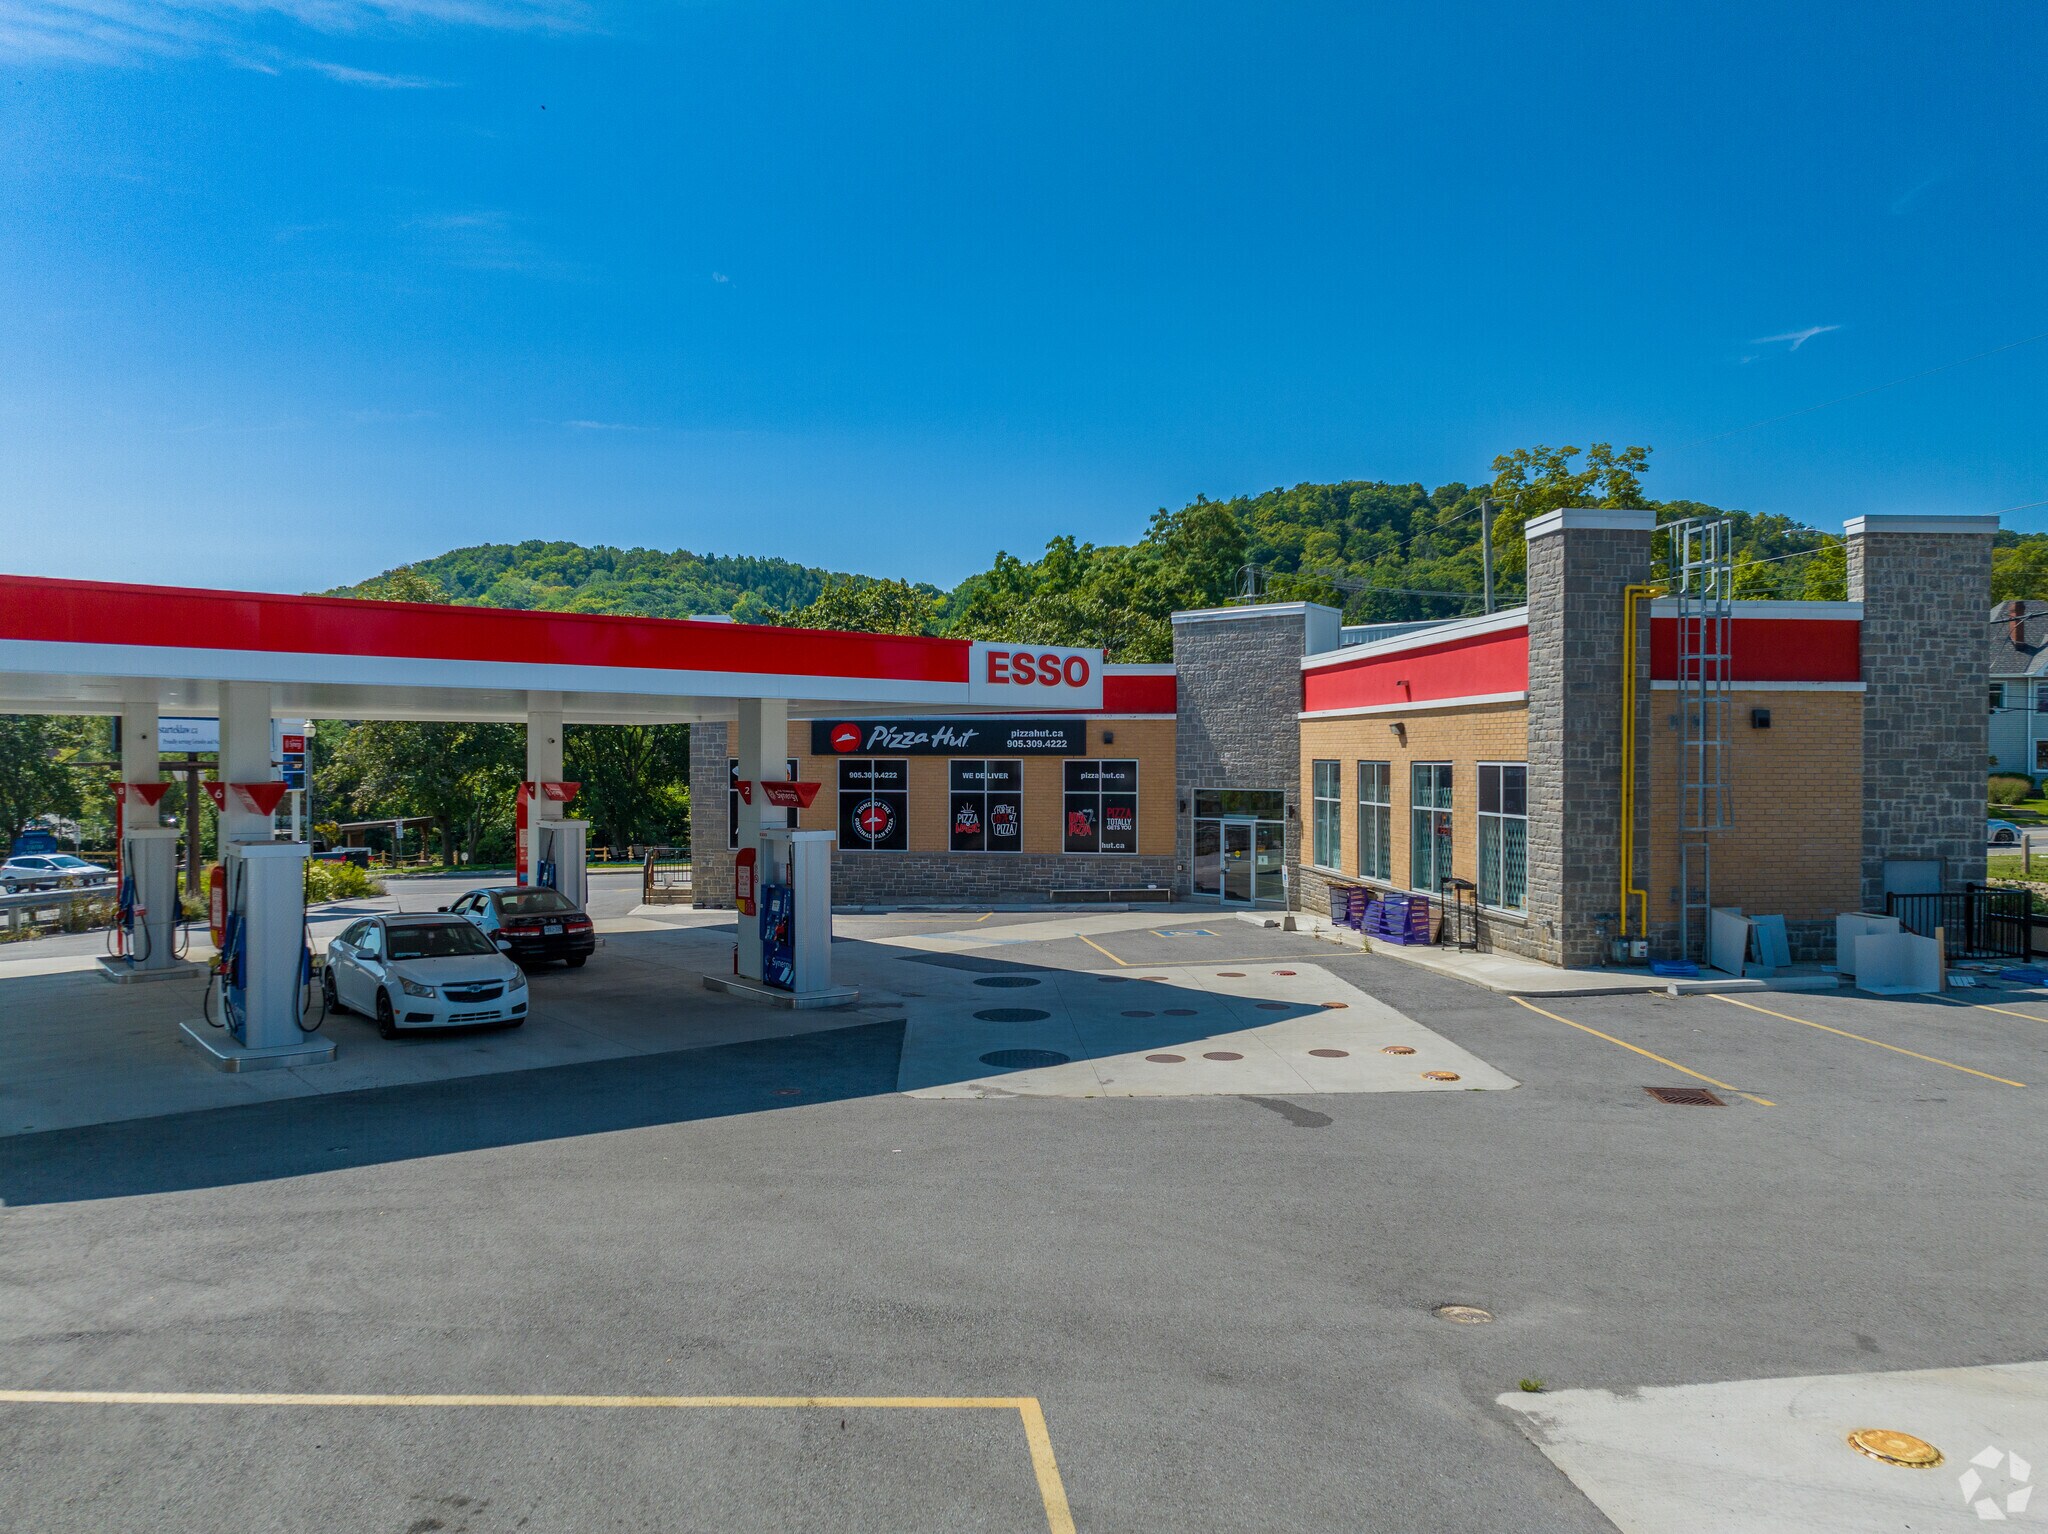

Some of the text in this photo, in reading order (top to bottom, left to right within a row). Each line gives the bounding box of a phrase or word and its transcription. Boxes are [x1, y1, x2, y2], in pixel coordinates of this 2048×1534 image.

[986, 651, 1090, 688] ESSO
[866, 725, 980, 750] Pizza Hut
[1011, 728, 1064, 739] pizzahut.ca
[1006, 739, 1068, 749] 905.309.4222
[848, 771, 898, 779] 905.309.4222
[1080, 772, 1125, 780] pizzahut.ca
[118, 787, 124, 795] 8
[214, 789, 223, 799] 6
[744, 786, 750, 795] 2
[856, 801, 872, 815] HOME
[882, 803, 892, 815] THE
[1106, 807, 1132, 818] PIZZA
[957, 813, 979, 824] PIZZA
[1106, 818, 1132, 826] TOTALLY
[996, 823, 1015, 835] PIZZA
